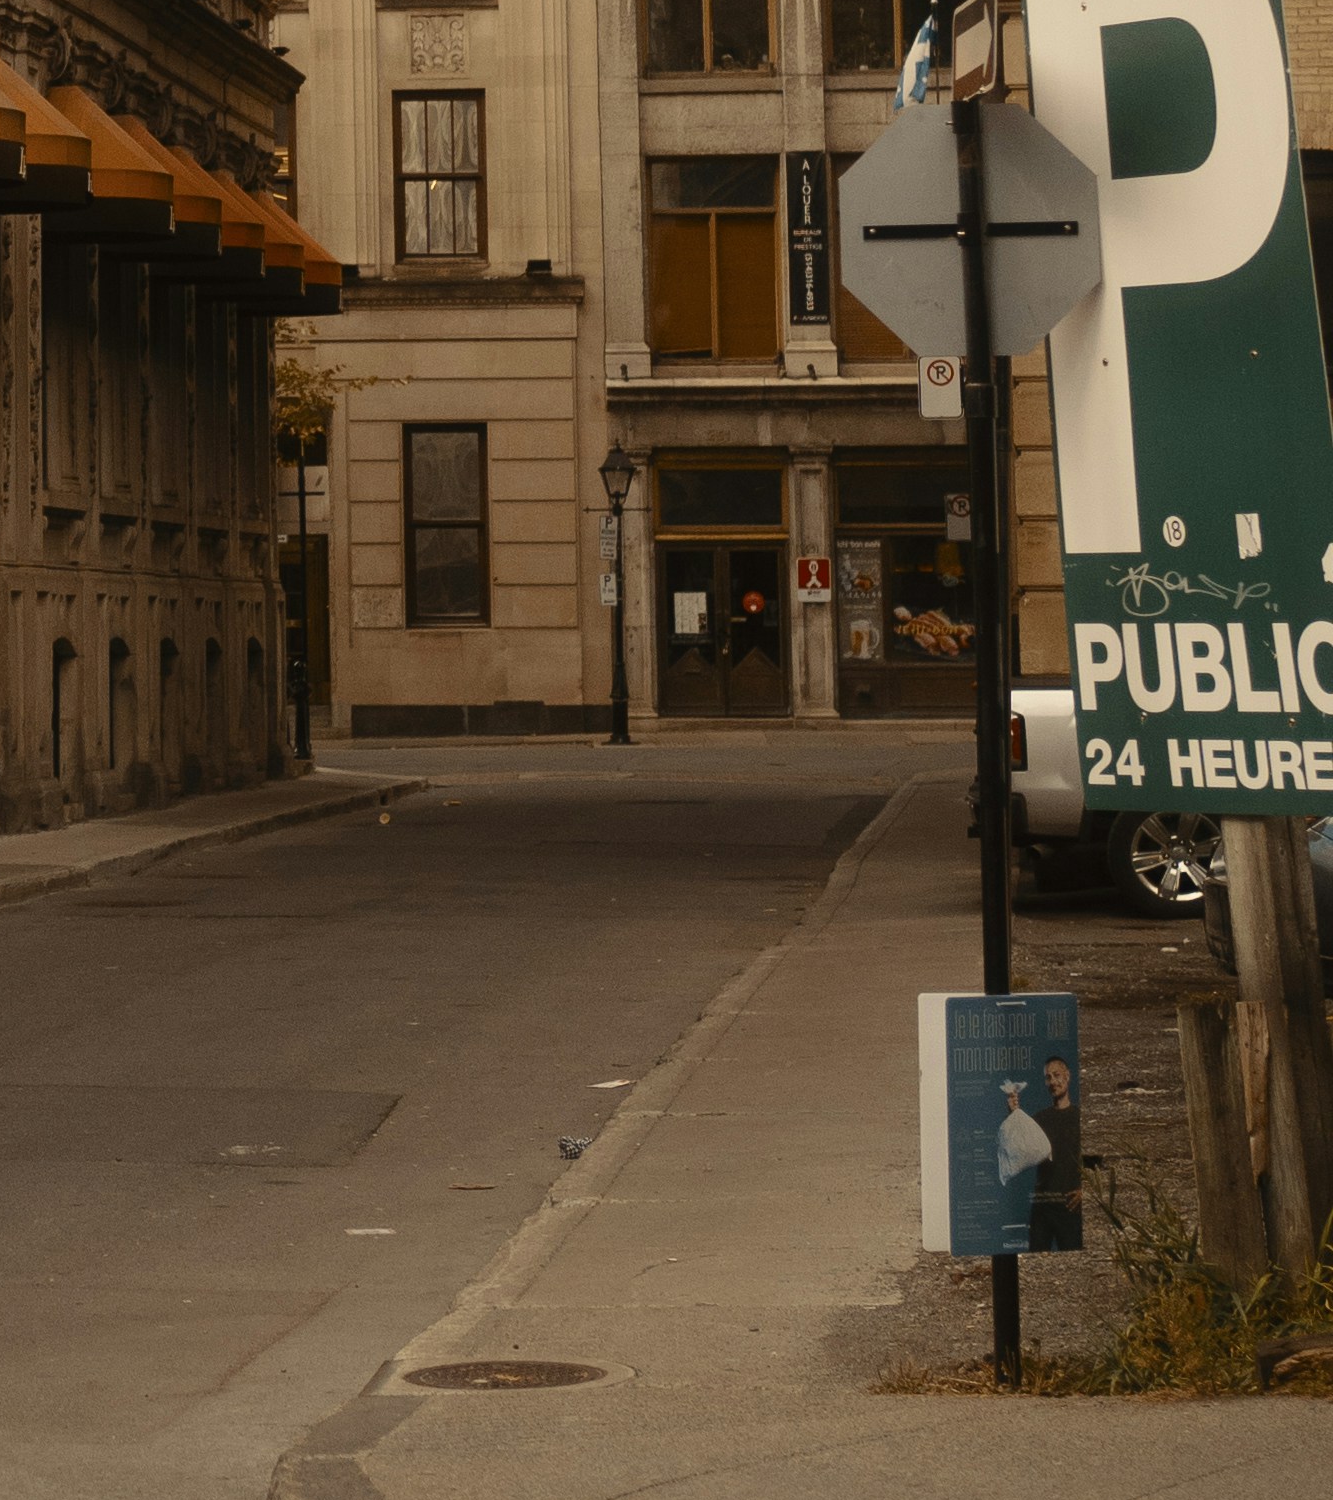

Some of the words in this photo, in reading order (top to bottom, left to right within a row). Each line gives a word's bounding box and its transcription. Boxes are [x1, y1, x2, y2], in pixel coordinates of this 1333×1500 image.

[802, 174, 812, 225] LOUER
[1166, 520, 1183, 542] 18
[1074, 621, 1333, 715] PUBLIC
[1085, 738, 1146, 786] 24
[1167, 738, 1333, 791] HEURE
[953, 1009, 966, 1040] Je
[968, 1009, 980, 1039] le
[983, 1008, 1005, 1039] fais
[1008, 1012, 1036, 1040] pour
[953, 1047, 982, 1072] mon
